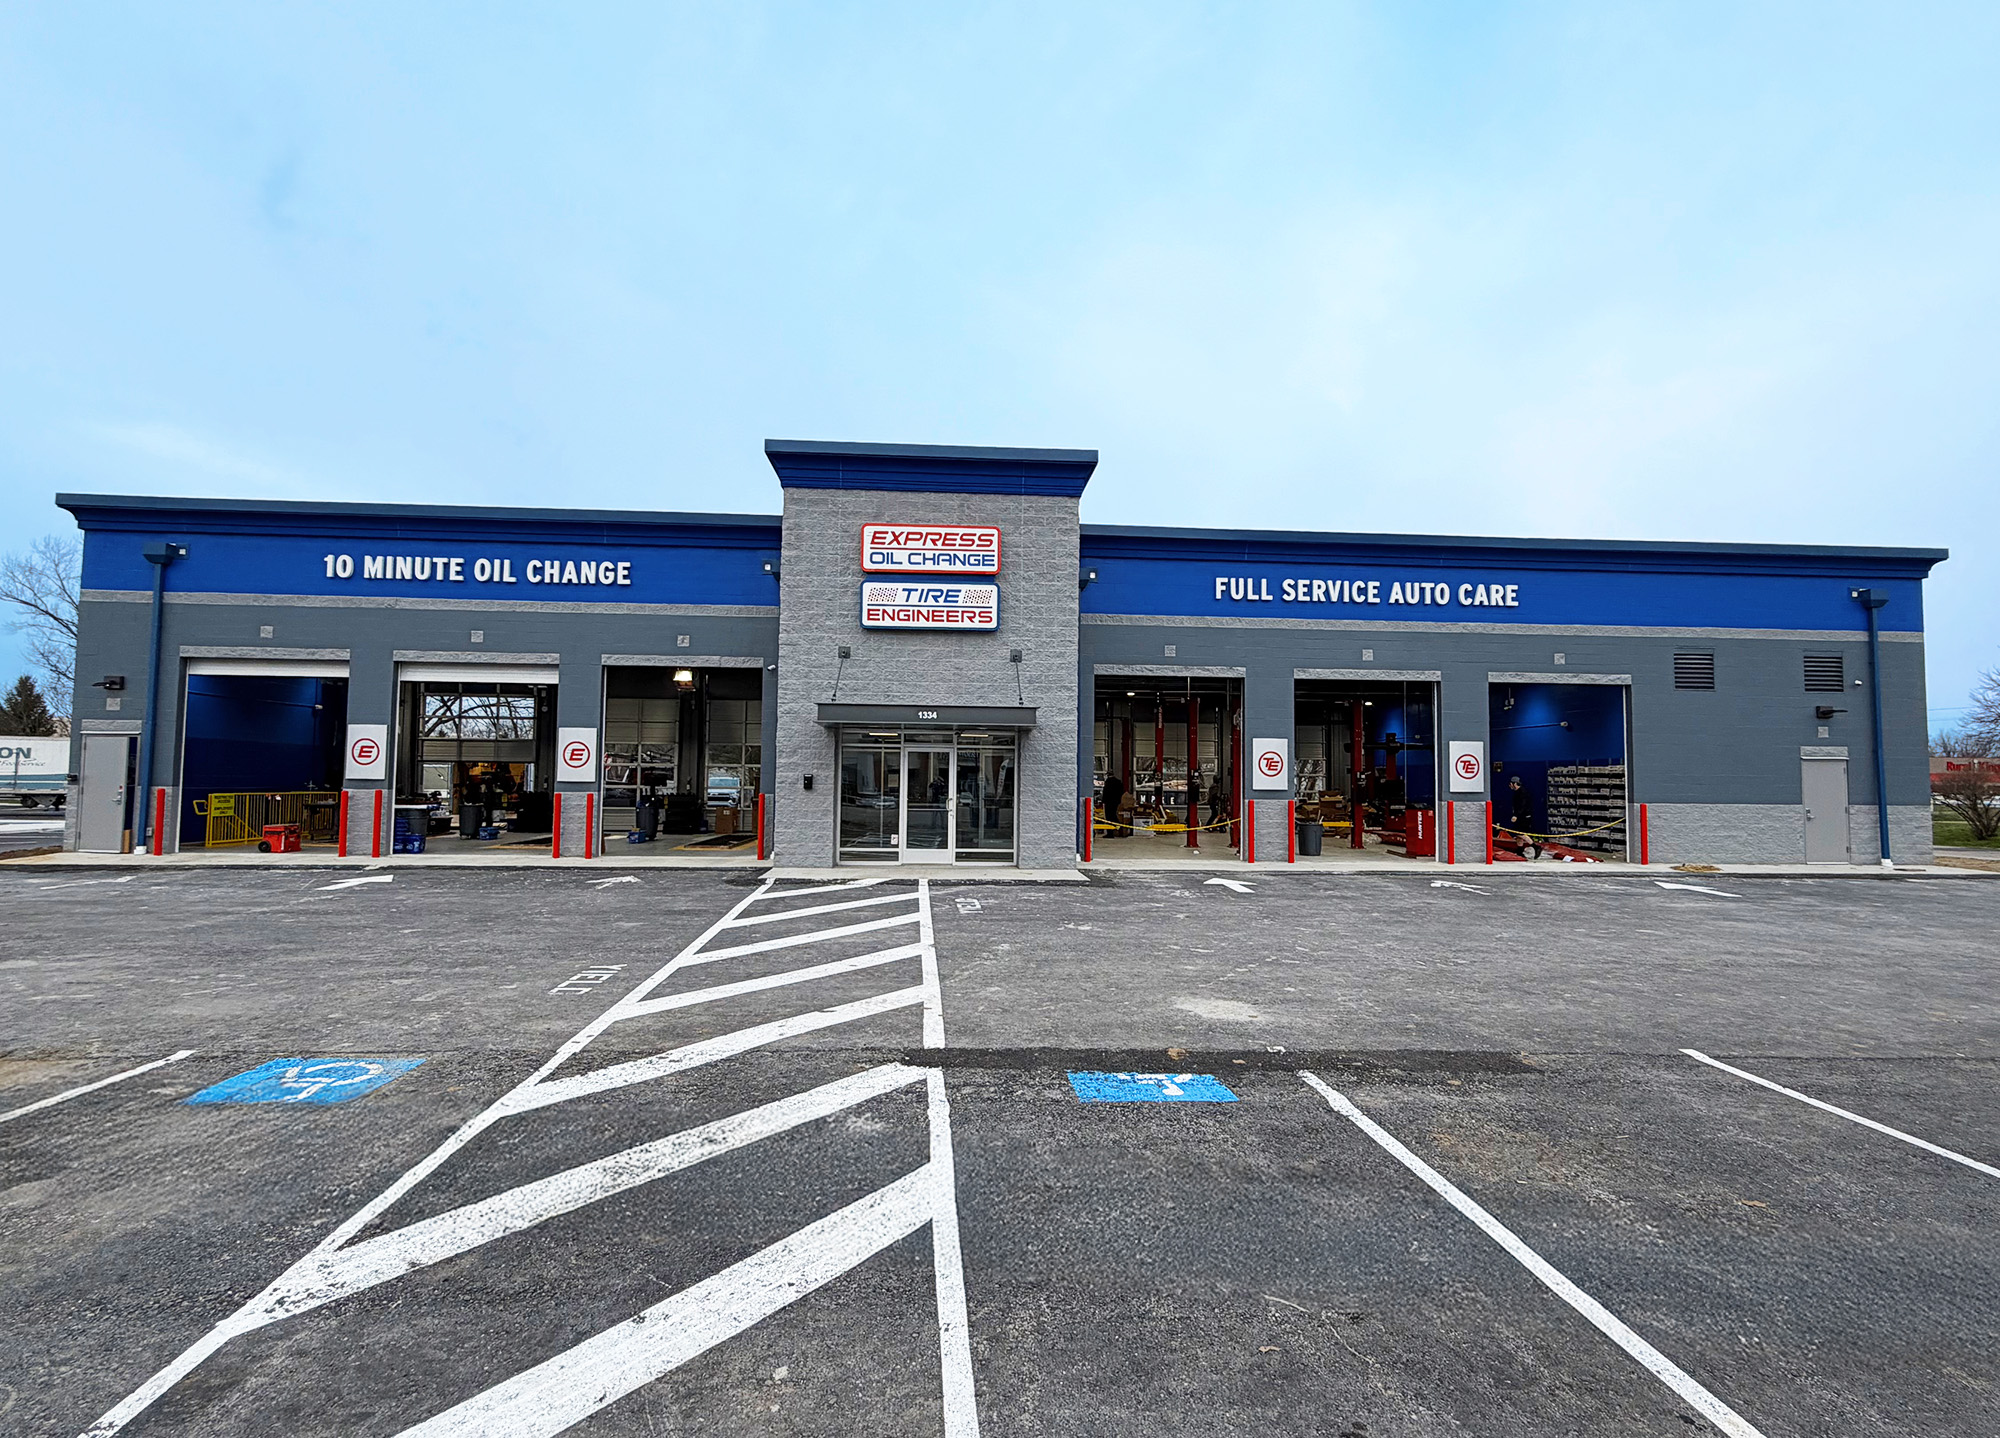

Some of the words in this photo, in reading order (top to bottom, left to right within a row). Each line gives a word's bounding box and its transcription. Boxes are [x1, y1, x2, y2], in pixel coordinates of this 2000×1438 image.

[870, 530, 995, 547] EXPRESS
[869, 551, 903, 565] OIL
[908, 552, 995, 567] CHANGE
[323, 554, 354, 579] 10
[363, 555, 465, 581] MINUTE
[474, 558, 517, 583] OIL
[526, 559, 632, 585] CHANGE
[902, 587, 962, 604] TIRE
[1215, 577, 1273, 601] FULL
[1281, 578, 1381, 604] SERVICE
[1388, 581, 1450, 605] AUTO
[1457, 583, 1519, 607] CARE
[867, 608, 993, 624] ENGINEERS
[917, 711, 938, 720] 1334
